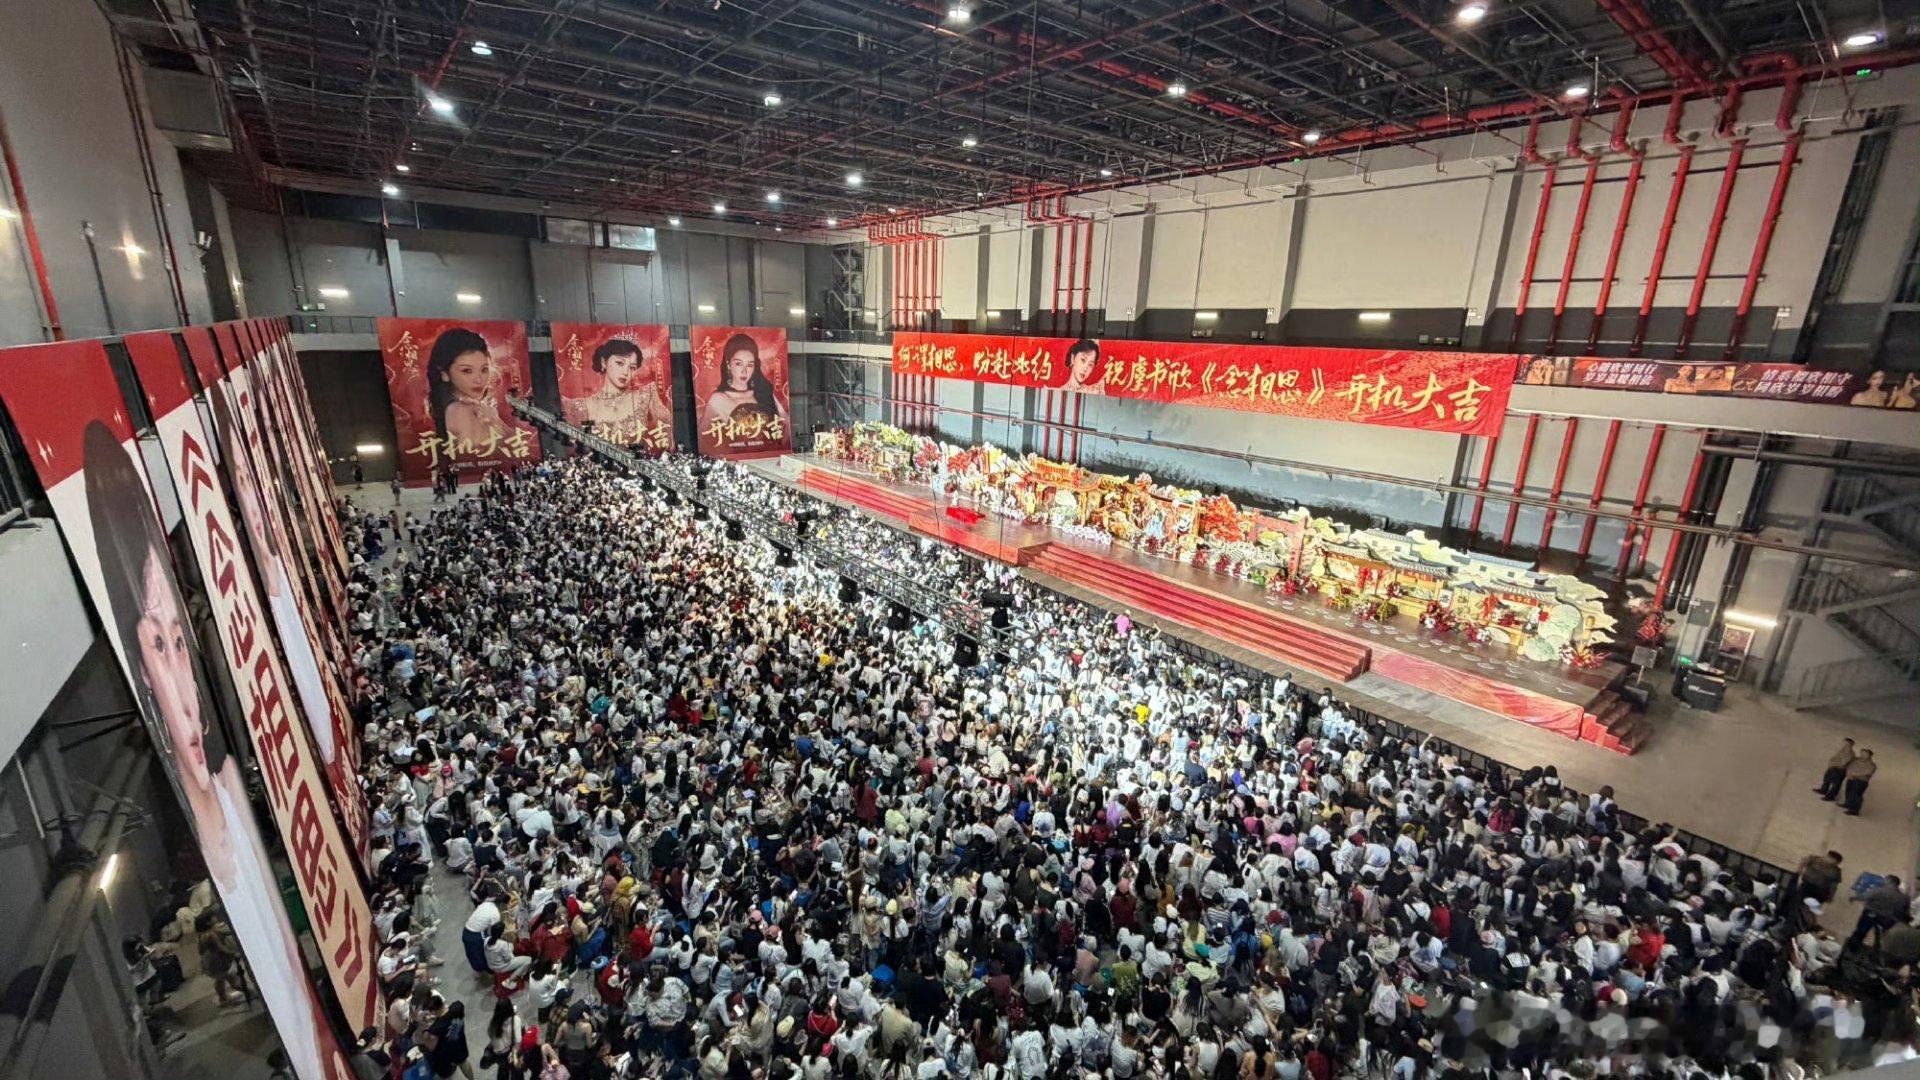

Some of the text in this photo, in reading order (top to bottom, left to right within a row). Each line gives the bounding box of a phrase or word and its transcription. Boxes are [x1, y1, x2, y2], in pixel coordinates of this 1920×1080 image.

[404, 426, 534, 470] 开机大吉
[591, 419, 671, 451] 机大吉
[701, 412, 786, 448] 开机大吉
